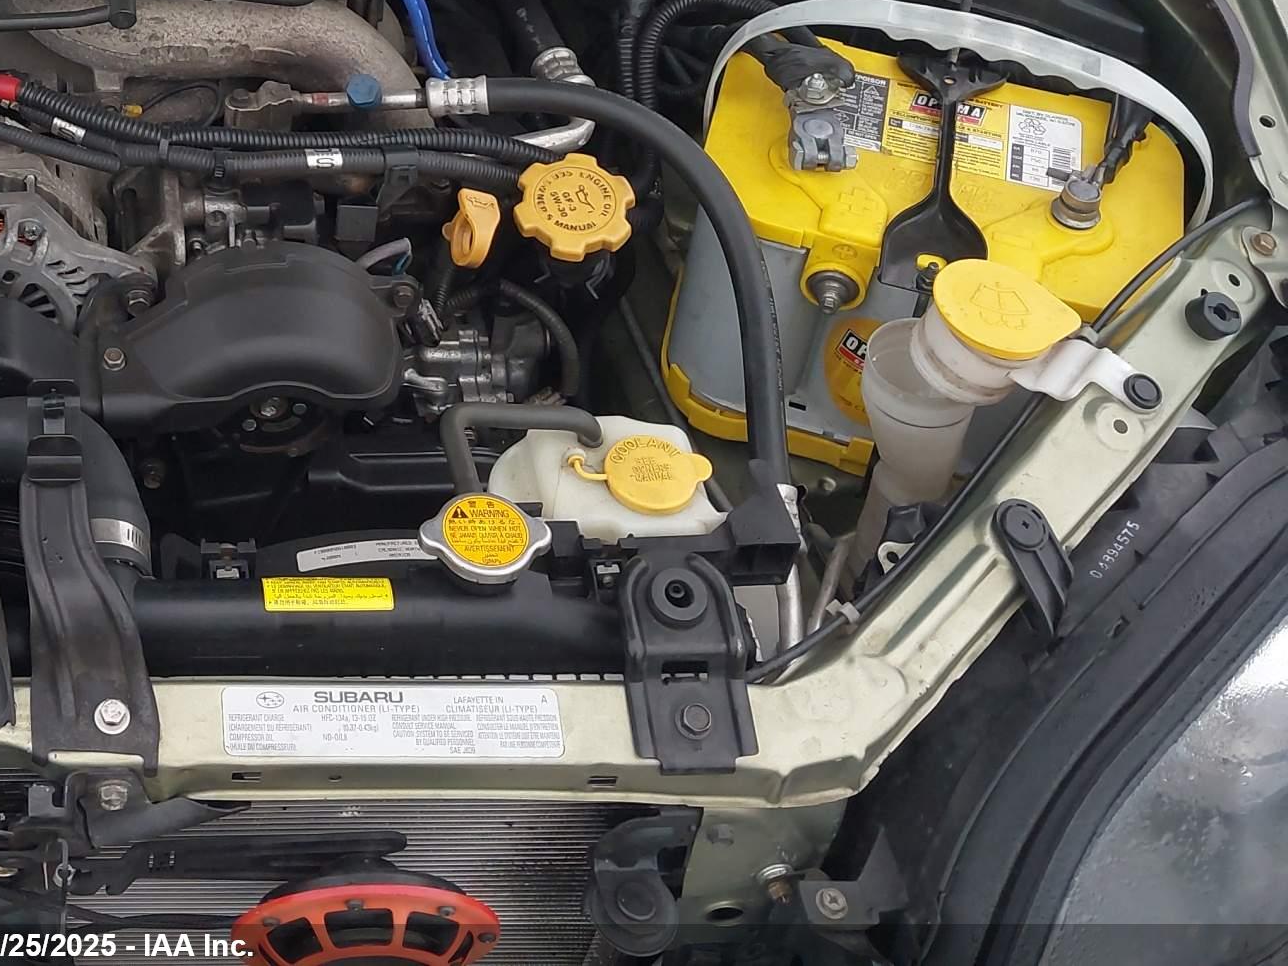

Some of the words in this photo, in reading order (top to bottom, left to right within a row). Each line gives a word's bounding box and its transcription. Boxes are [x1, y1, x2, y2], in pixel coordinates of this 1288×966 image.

[916, 94, 981, 118] OPMA
[313, 691, 404, 704] SUBARU
[453, 695, 494, 704] LAFAYETTE
[495, 695, 504, 704] IN
[541, 694, 548, 704] A
[292, 704, 309, 713] AIR
[311, 704, 377, 713] CONDITIONER
[378, 704, 420, 714] (LI-TYPE)
[501, 705, 538, 714] (LI-TYPE)
